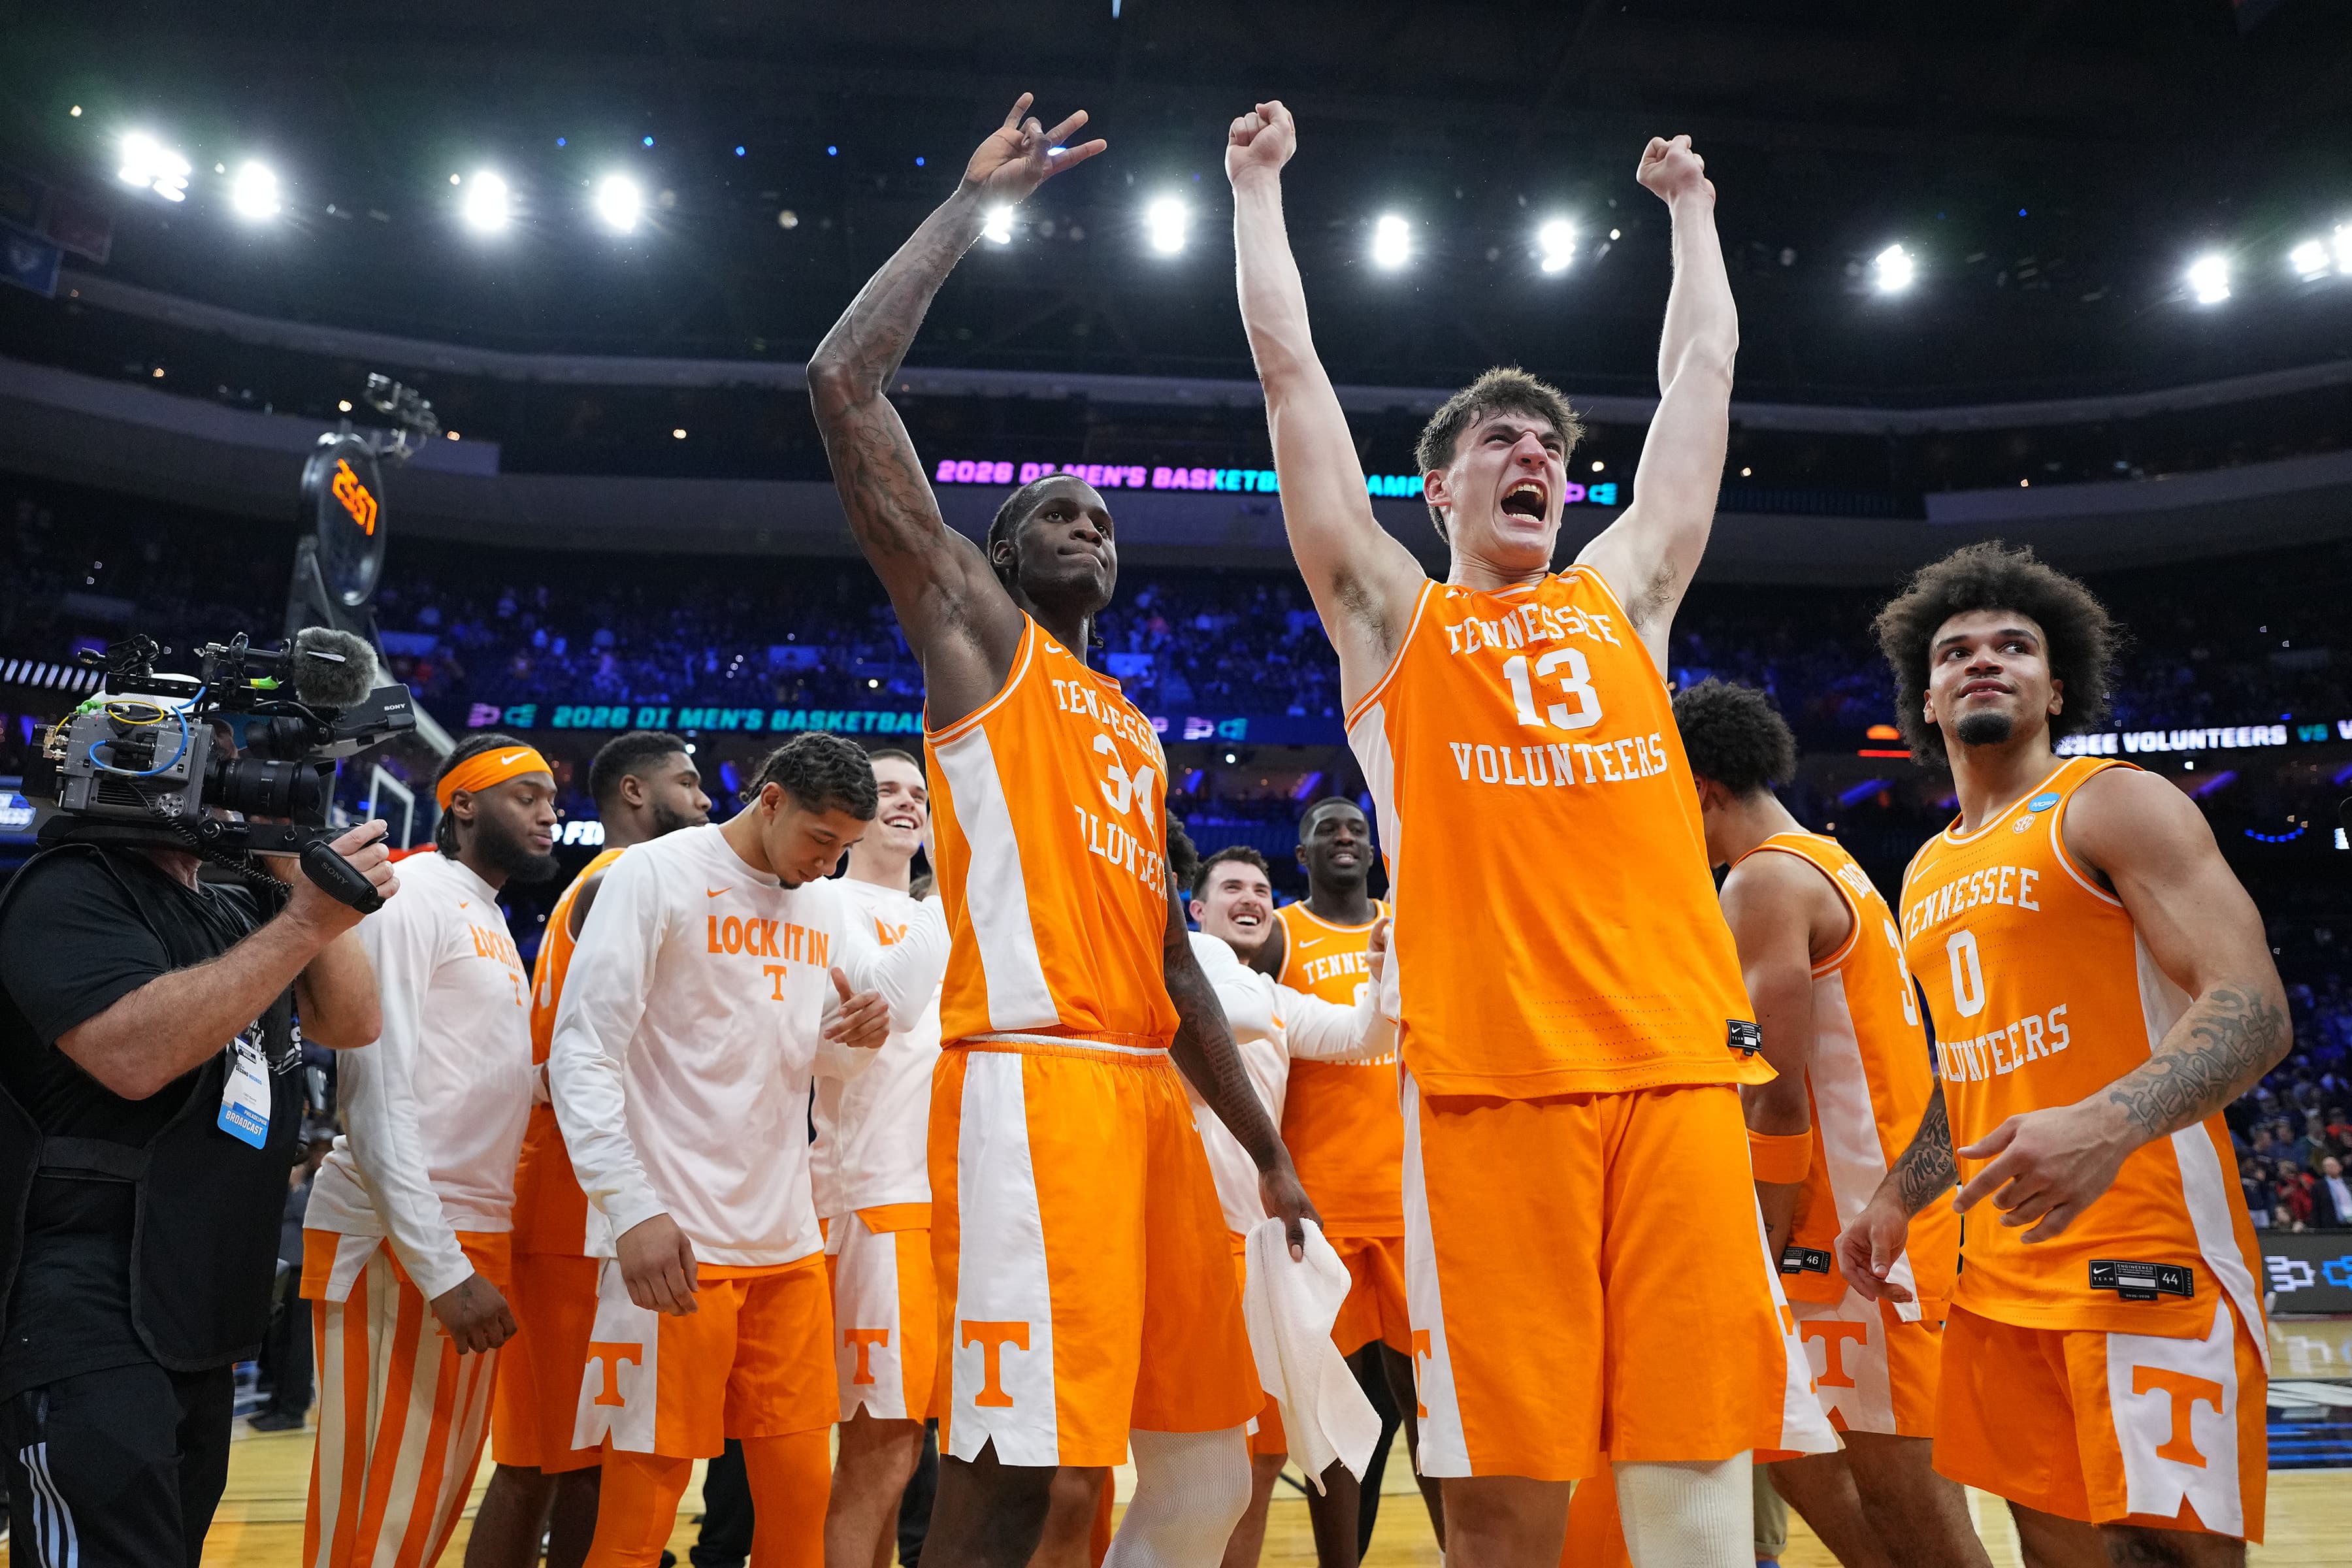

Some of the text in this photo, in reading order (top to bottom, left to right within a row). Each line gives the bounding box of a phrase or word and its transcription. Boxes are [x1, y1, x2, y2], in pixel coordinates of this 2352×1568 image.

[936, 459, 1014, 484] 2026
[1152, 466, 1278, 493] BASKETB
[1445, 603, 1622, 656] TENNESSEE
[384, 703, 406, 711] SONY
[1503, 647, 1603, 730] 13
[553, 706, 630, 728] 2026
[636, 707, 672, 729] DI
[678, 708, 763, 730] MEN'S
[2123, 725, 2287, 753] VOLUNTEERS
[2297, 723, 2328, 742] VS
[1449, 732, 1668, 787] VOLUNTEERS
[1093, 733, 1156, 841] 34
[321, 861, 349, 885] SONY
[1903, 866, 2040, 952] TENNESSEE
[708, 915, 780, 957] LOCK
[784, 923, 804, 962] IT
[808, 928, 828, 968] IN
[1303, 951, 1370, 985] TENNE
[763, 964, 787, 1001] T
[1946, 929, 1985, 1018] 0
[1935, 1004, 2070, 1083] OLUNTEERS
[225, 1110, 263, 1136] BROADCAST
[1806, 1255, 1819, 1265] 46
[2162, 1273, 2178, 1286] 44
[587, 1341, 643, 1407] T
[844, 1328, 889, 1384] T
[960, 1320, 1030, 1407] T
[1801, 1320, 1867, 1388] T
[2132, 1364, 2224, 1469] T
